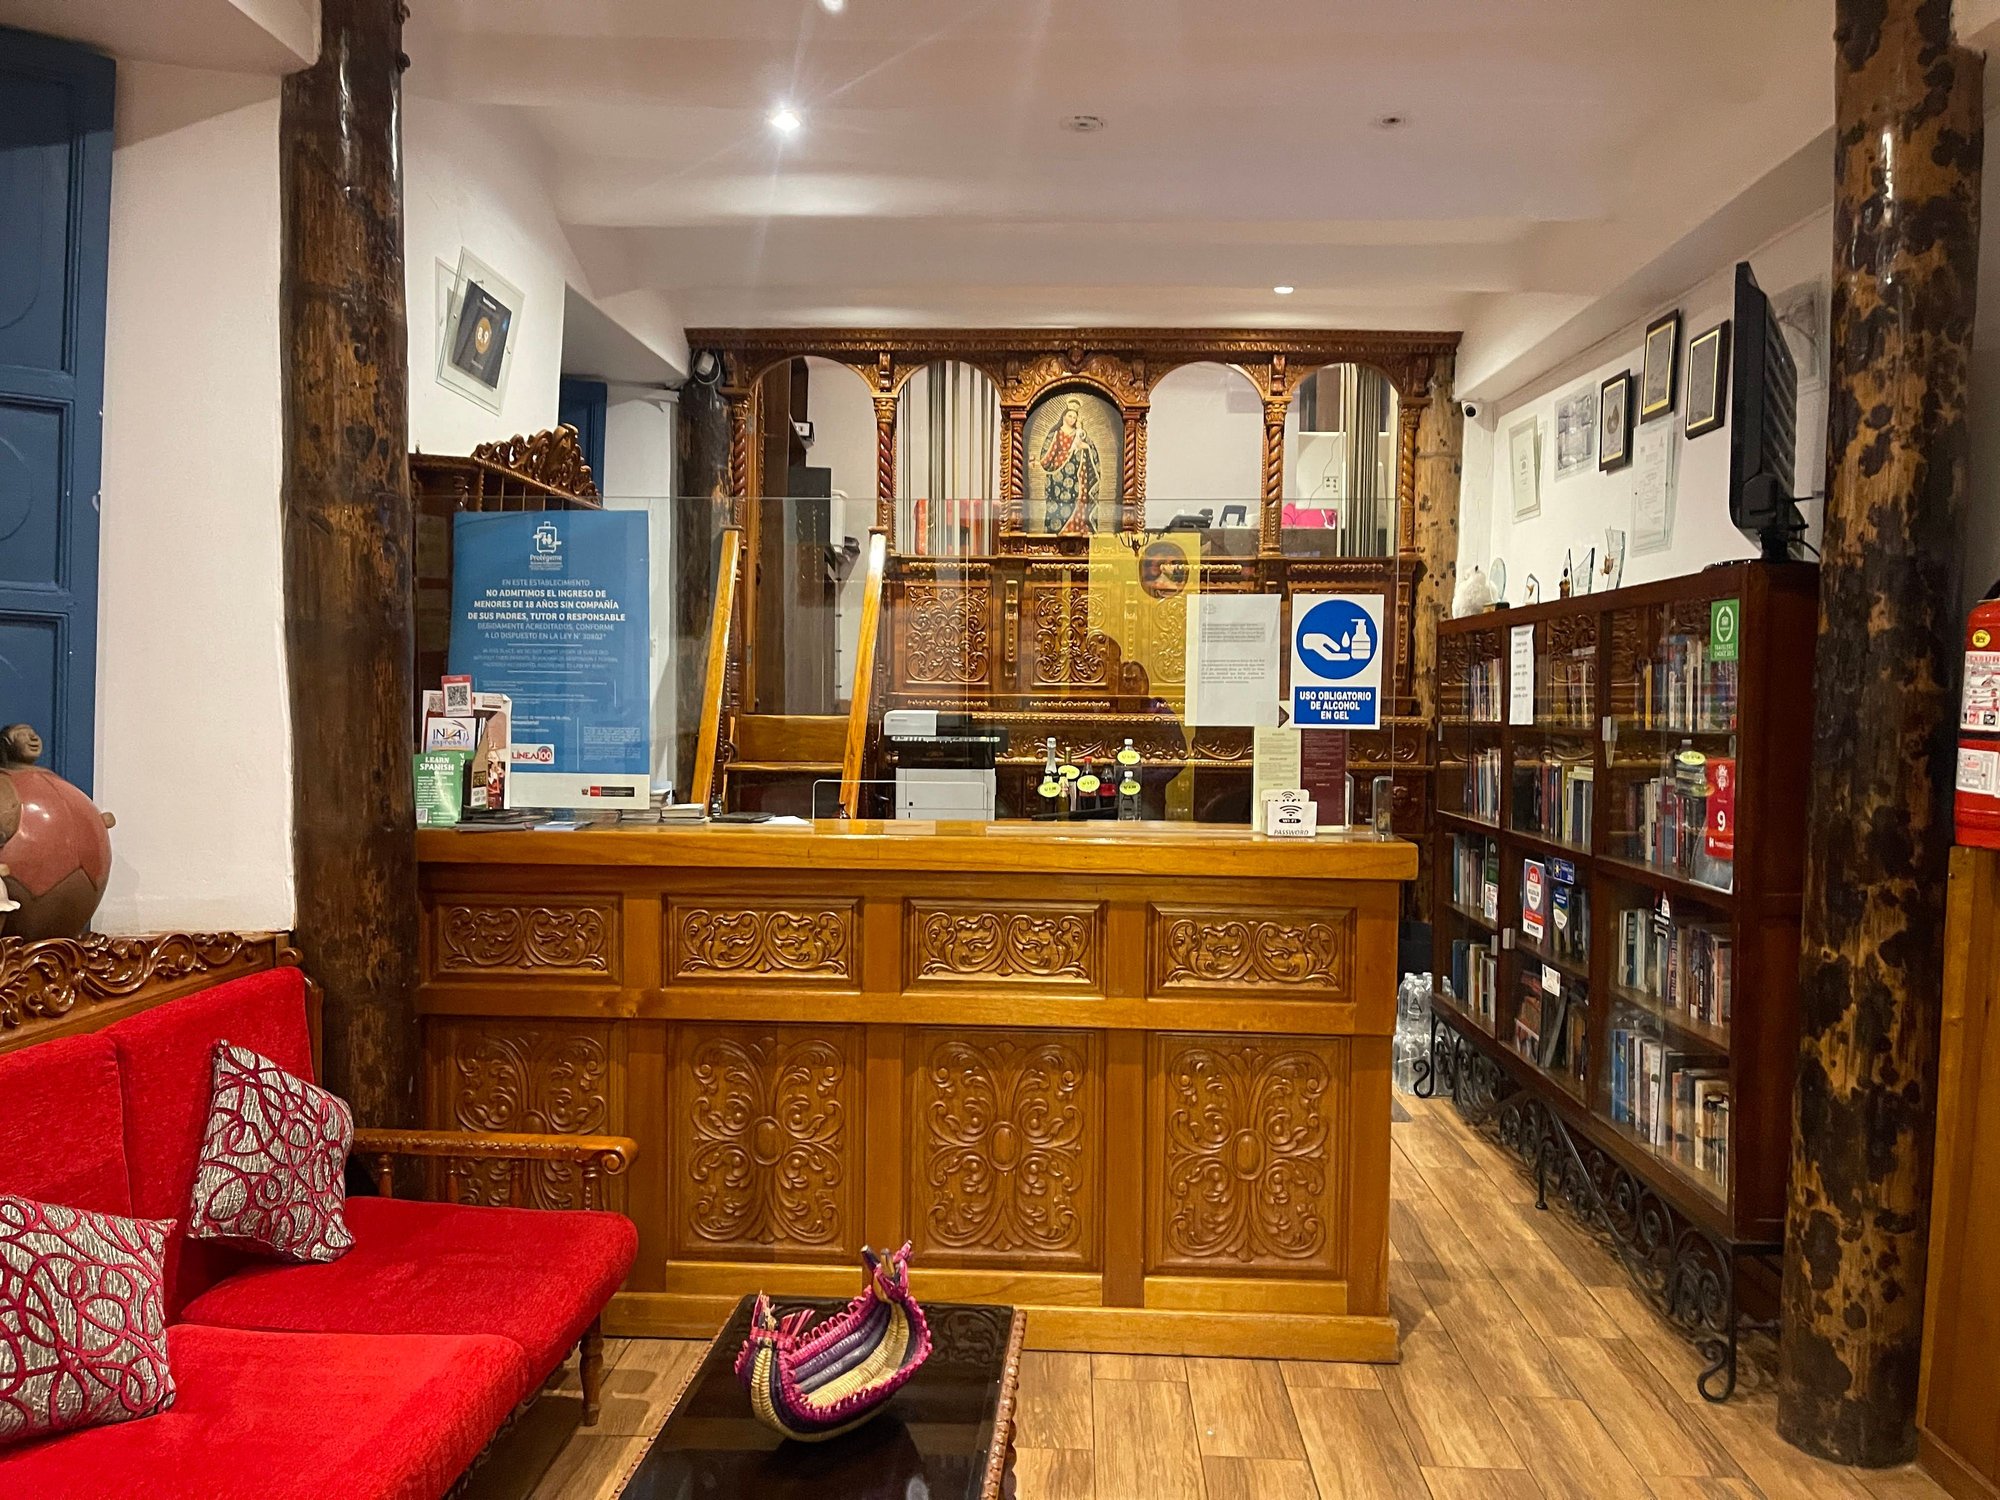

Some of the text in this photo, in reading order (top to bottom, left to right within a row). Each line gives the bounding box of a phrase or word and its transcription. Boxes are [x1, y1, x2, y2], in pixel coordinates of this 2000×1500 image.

[529, 579, 590, 587] ESTABLECIMIENTO
[486, 589, 498, 597] NO
[499, 589, 545, 597] ADMITIMOS
[558, 590, 593, 598] INGRESO
[536, 599, 558, 608] AÑOS
[575, 599, 619, 609] COMPAÑÍA
[468, 612, 478, 620] DE
[479, 612, 494, 620] SUS
[496, 612, 529, 621] PADRES,
[567, 613, 625, 621] RESPONSABLE
[501, 632, 538, 640] DISPUESTO
[539, 632, 549, 640] EN
[550, 632, 558, 640] LA
[560, 632, 572, 640] LEY
[1300, 691, 1371, 701] USO OBLIGATORIO
[1310, 701, 1360, 711] DE ALCOHOL
[1320, 711, 1349, 720] EN GEL
[424, 756, 450, 764] LEARN
[419, 763, 455, 771] SPANISH
[1717, 810, 1726, 832] 9
